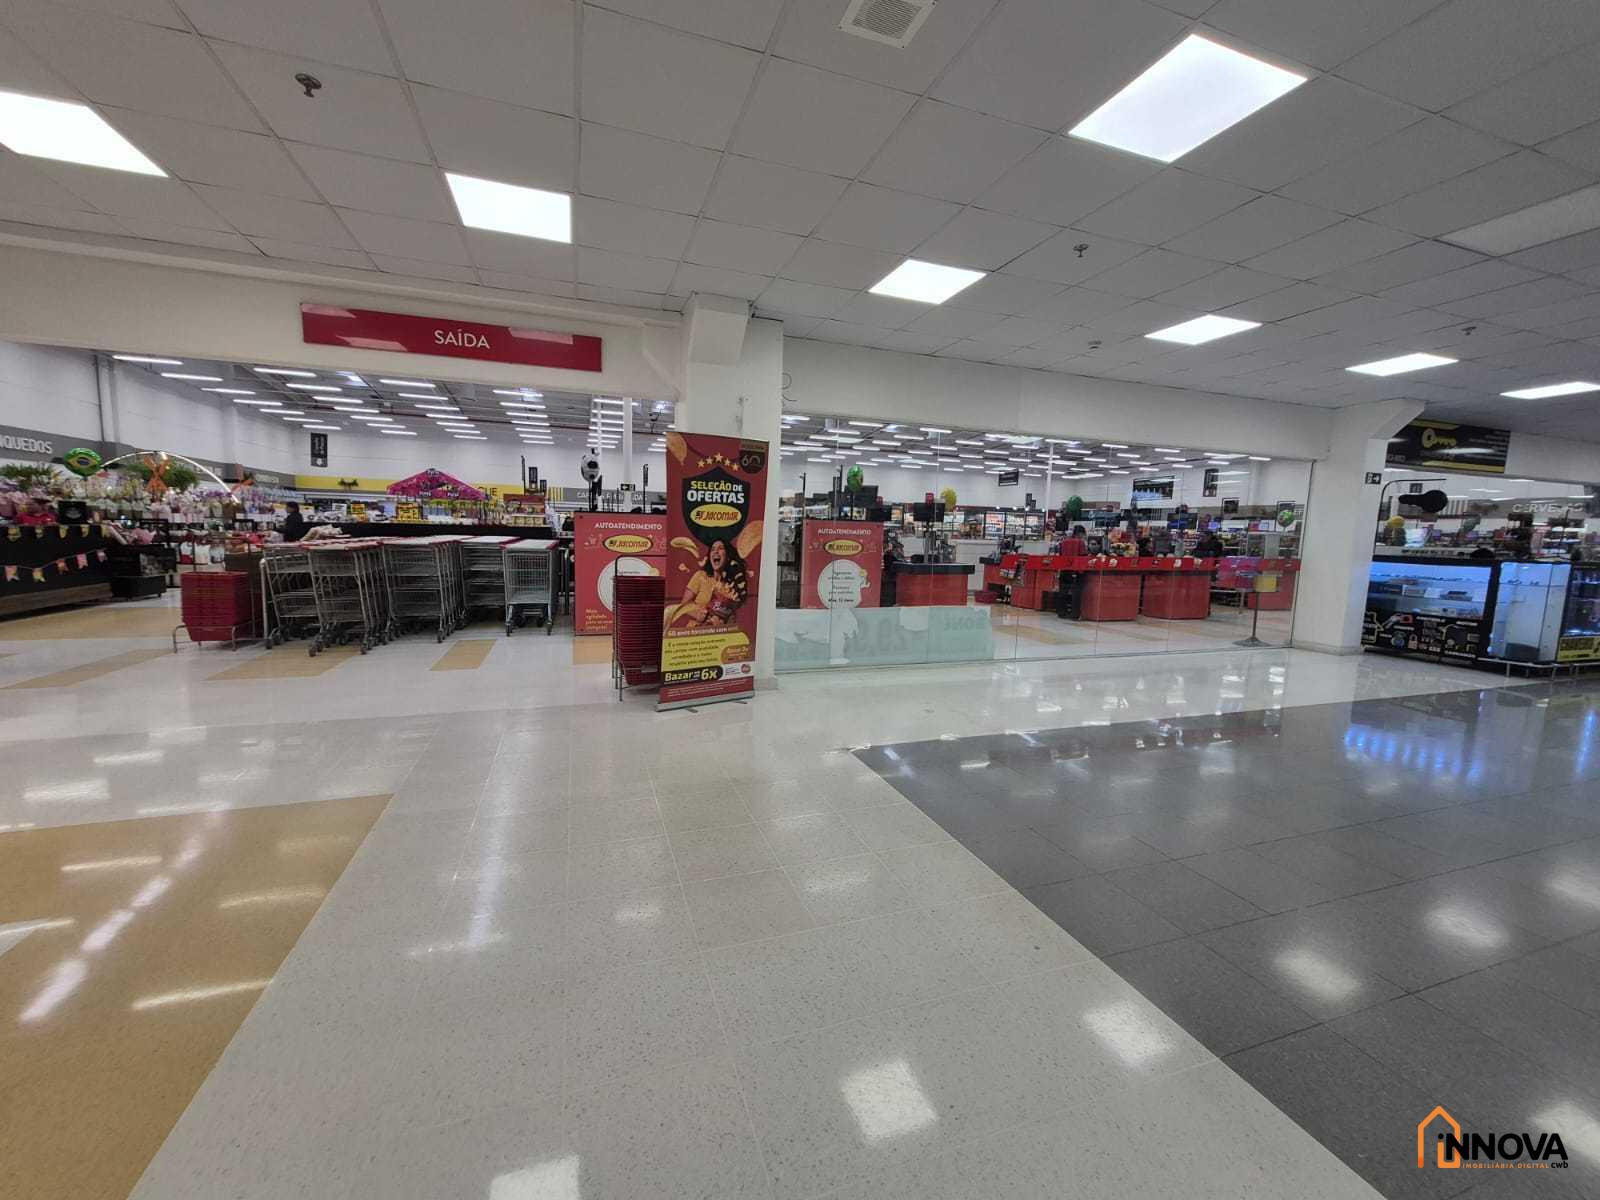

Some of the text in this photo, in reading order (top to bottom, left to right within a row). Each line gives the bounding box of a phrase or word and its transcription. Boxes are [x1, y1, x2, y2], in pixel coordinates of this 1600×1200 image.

[434, 328, 490, 349] SAÍDA
[690, 480, 743, 492] SELEÇÃO DE
[686, 490, 745, 504] OFERTAS
[665, 672, 693, 681] Bazar
[701, 668, 718, 680] 6x
